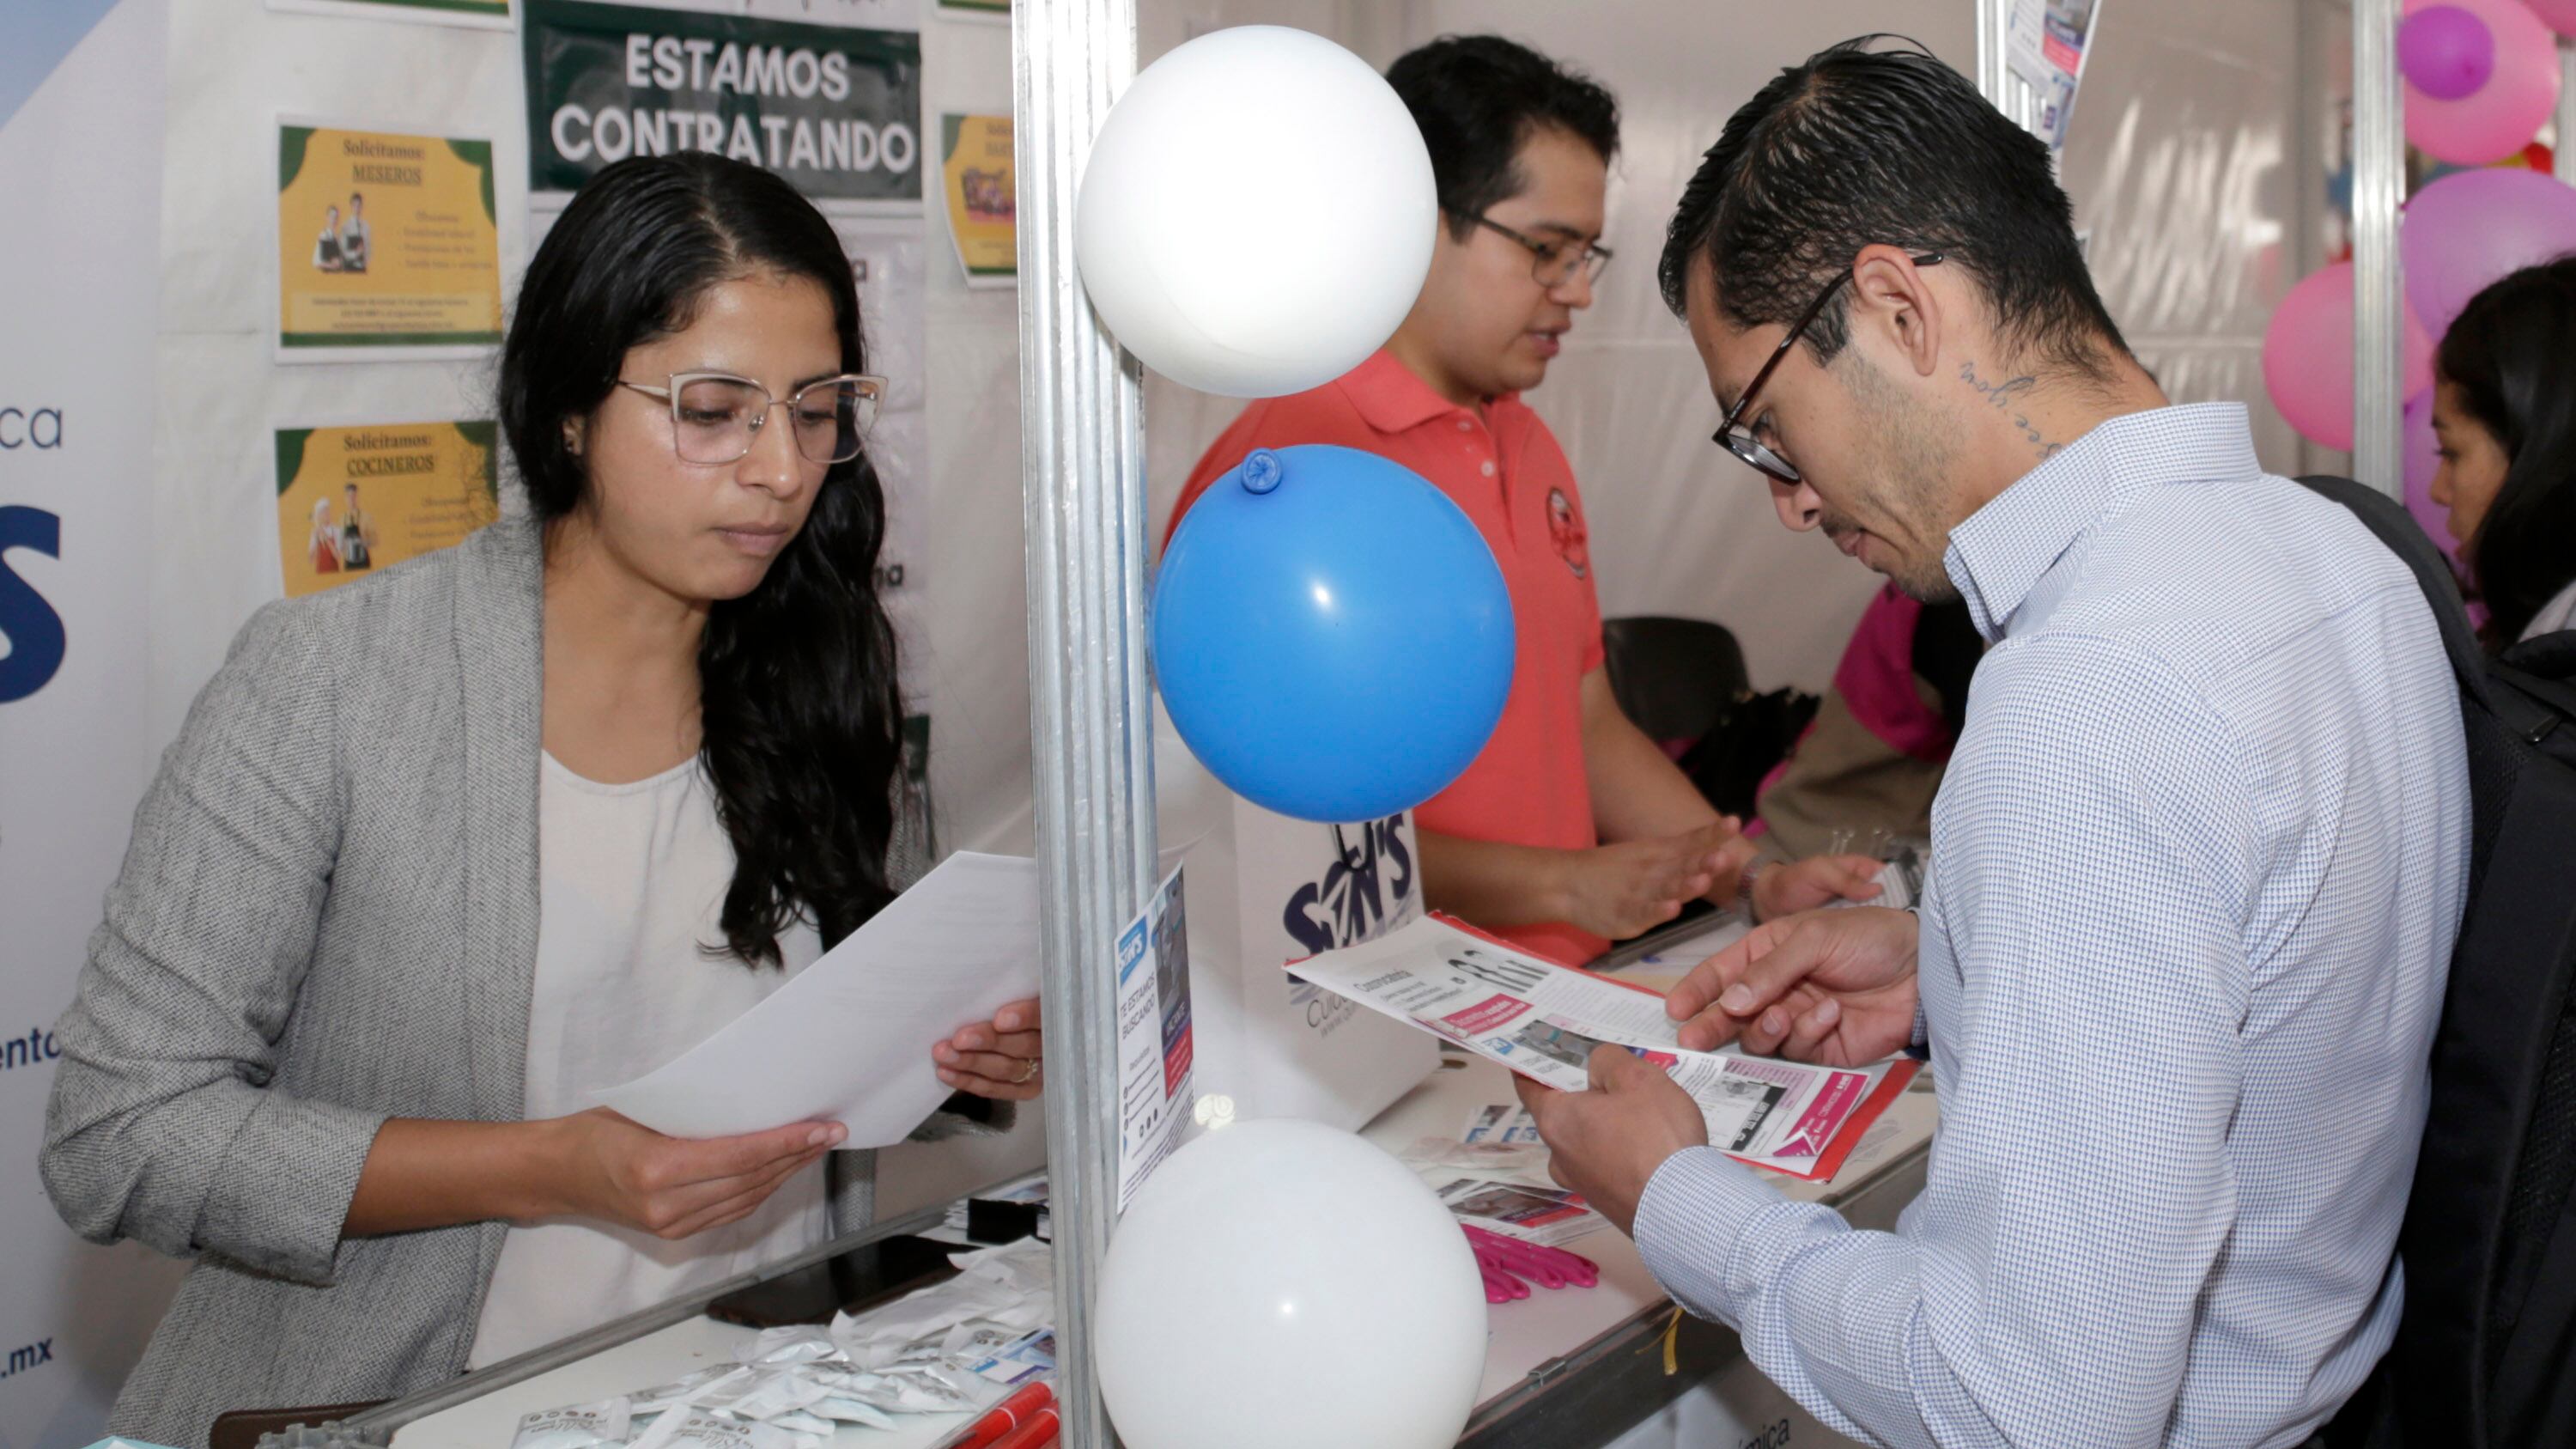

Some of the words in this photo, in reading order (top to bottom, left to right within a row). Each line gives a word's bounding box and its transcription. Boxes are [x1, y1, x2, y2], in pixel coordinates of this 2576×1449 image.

[626, 33, 850, 102] ESTAMOS
[551, 103, 915, 173] CONTRATANDO
[352, 163, 422, 184] MESEROS
[347, 454, 434, 475] COCINEROS
